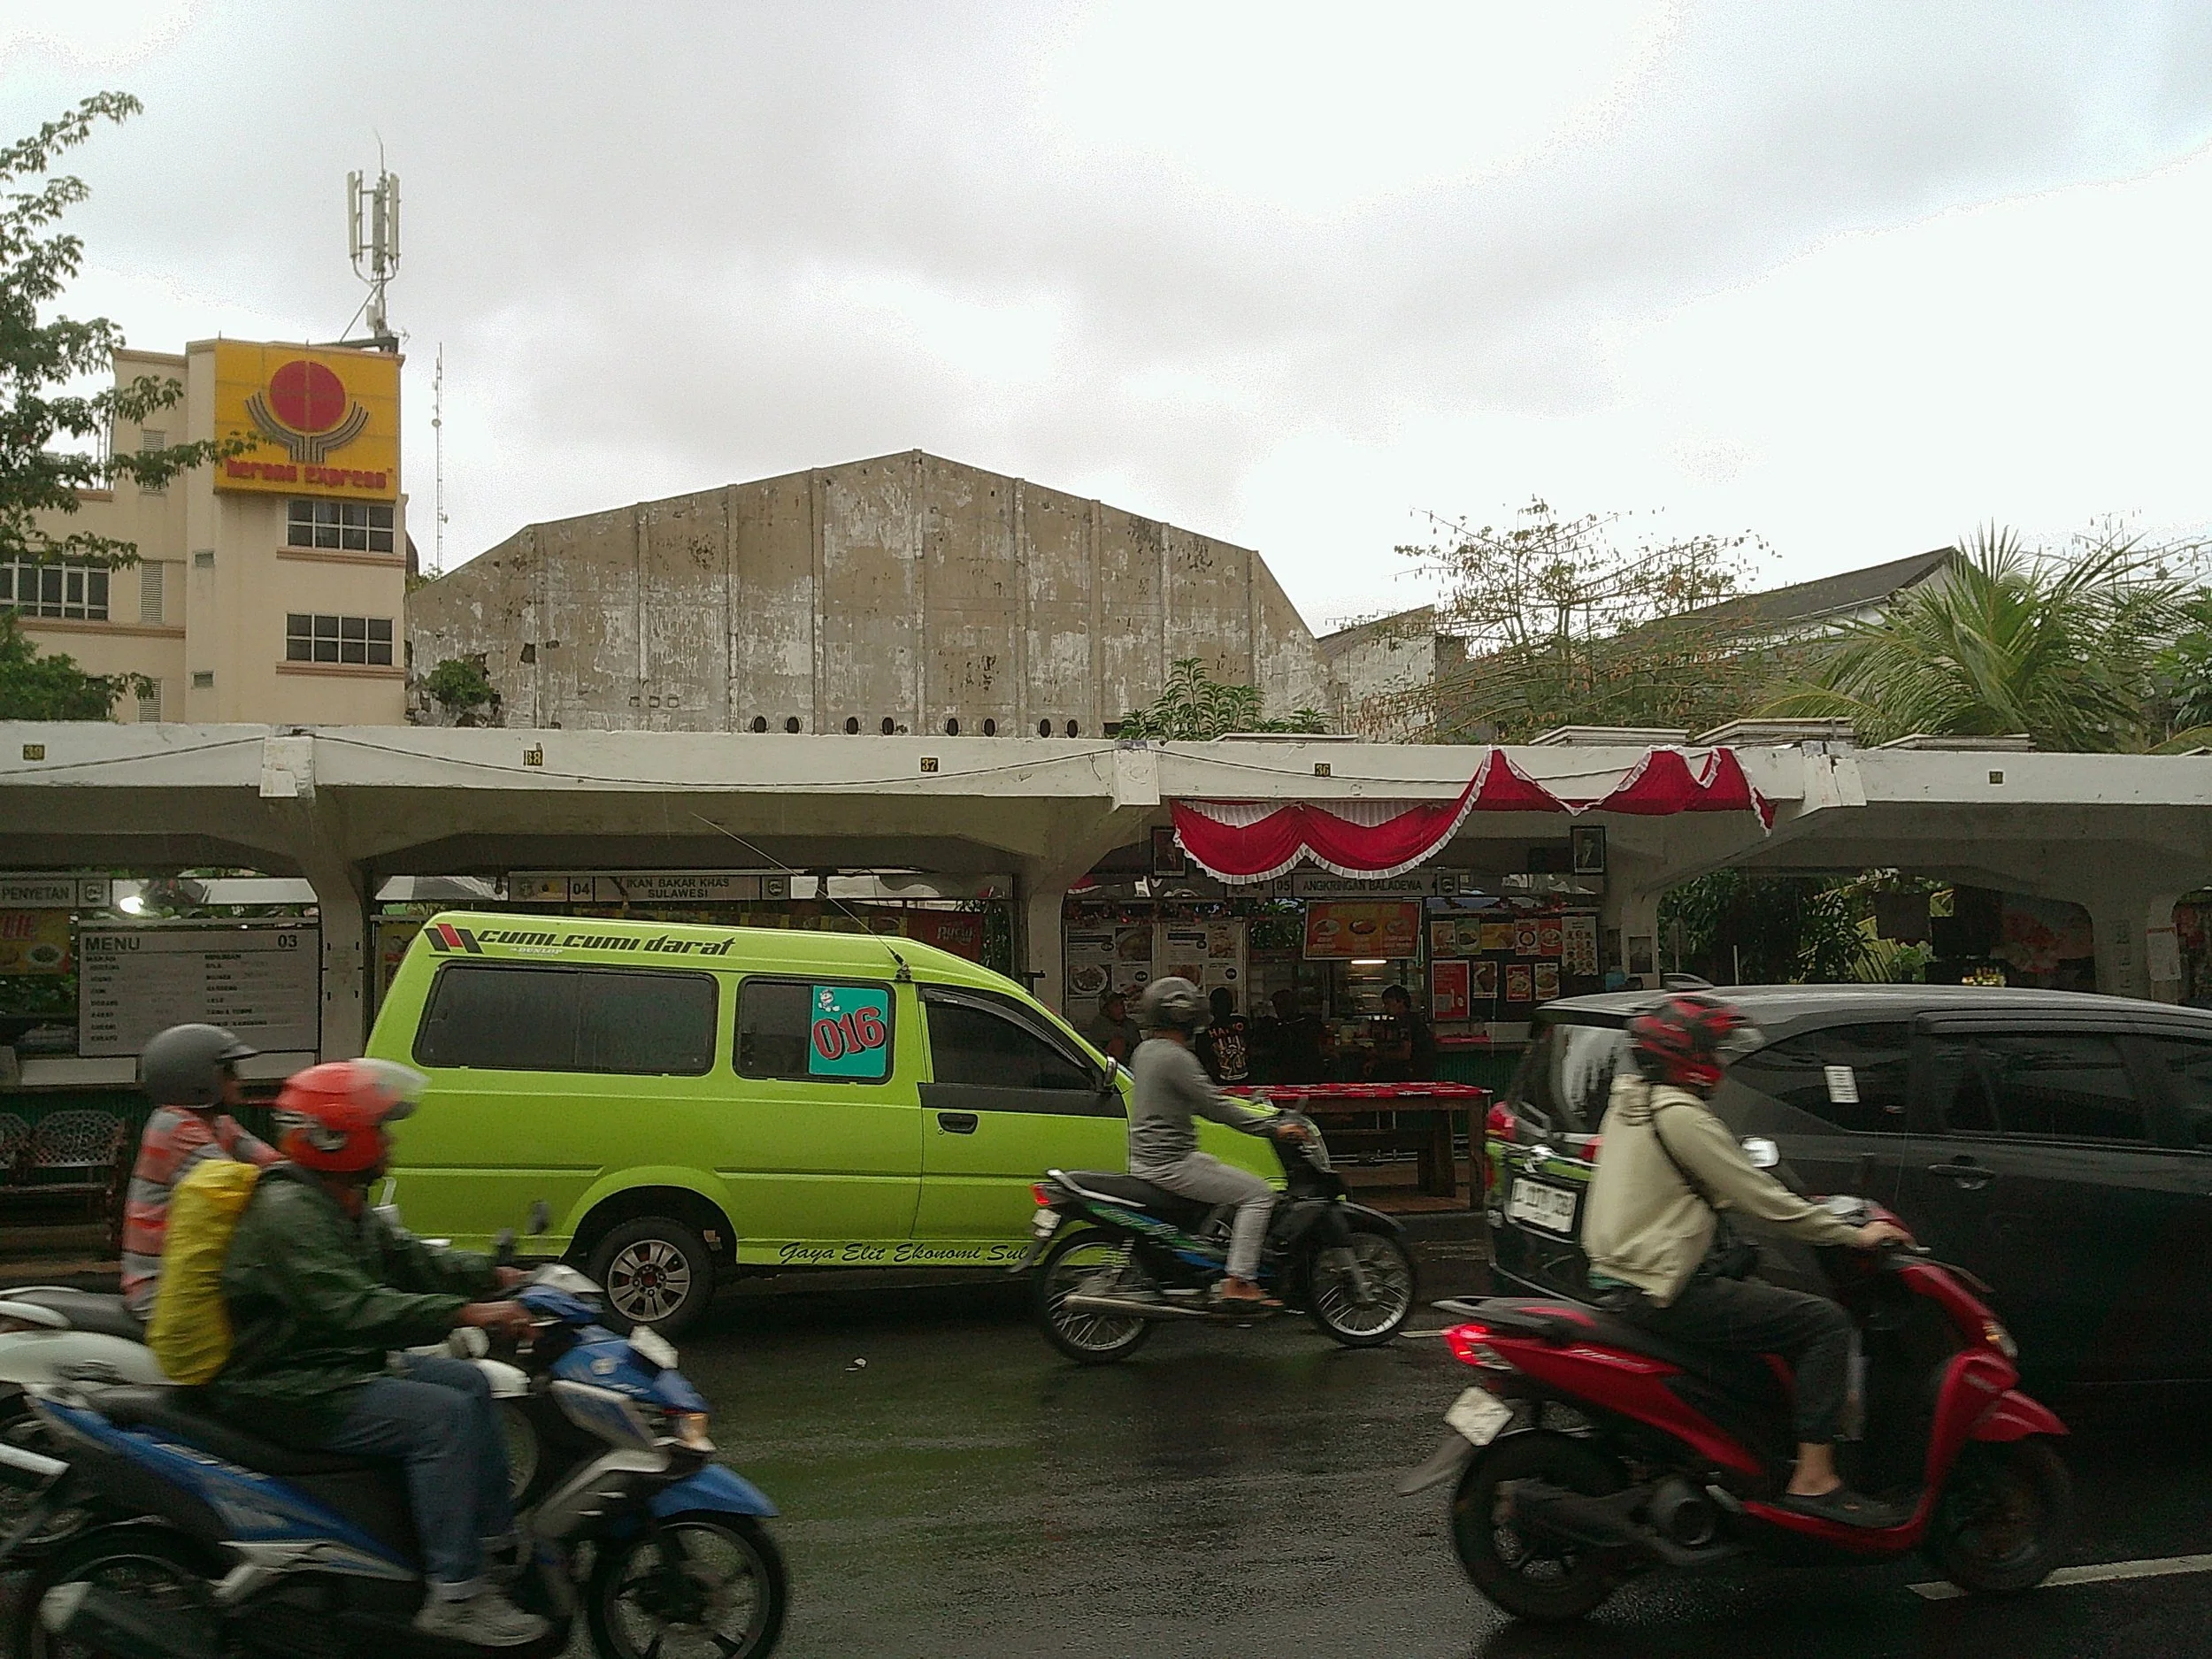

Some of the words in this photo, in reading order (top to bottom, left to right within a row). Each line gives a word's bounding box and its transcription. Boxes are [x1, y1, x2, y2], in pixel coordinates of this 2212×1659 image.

[922, 758, 936, 771] 37
[1316, 764, 1329, 776] 36
[627, 877, 653, 887] IKAN
[658, 878, 696, 887] BAKAR
[700, 878, 730, 887] KHAS
[1276, 879, 1290, 891] 05
[1, 887, 70, 900] PENYETAN
[572, 883, 590, 895] 04
[647, 888, 709, 898] SULAWESI
[85, 937, 140, 950] MENU
[277, 934, 297, 948] 03
[518, 947, 564, 956] DUNLOP
[813, 1006, 885, 1060] 016
[779, 1241, 835, 1264] Gaya
[841, 1242, 886, 1262] Elit
[893, 1242, 982, 1263] Ekonomi
